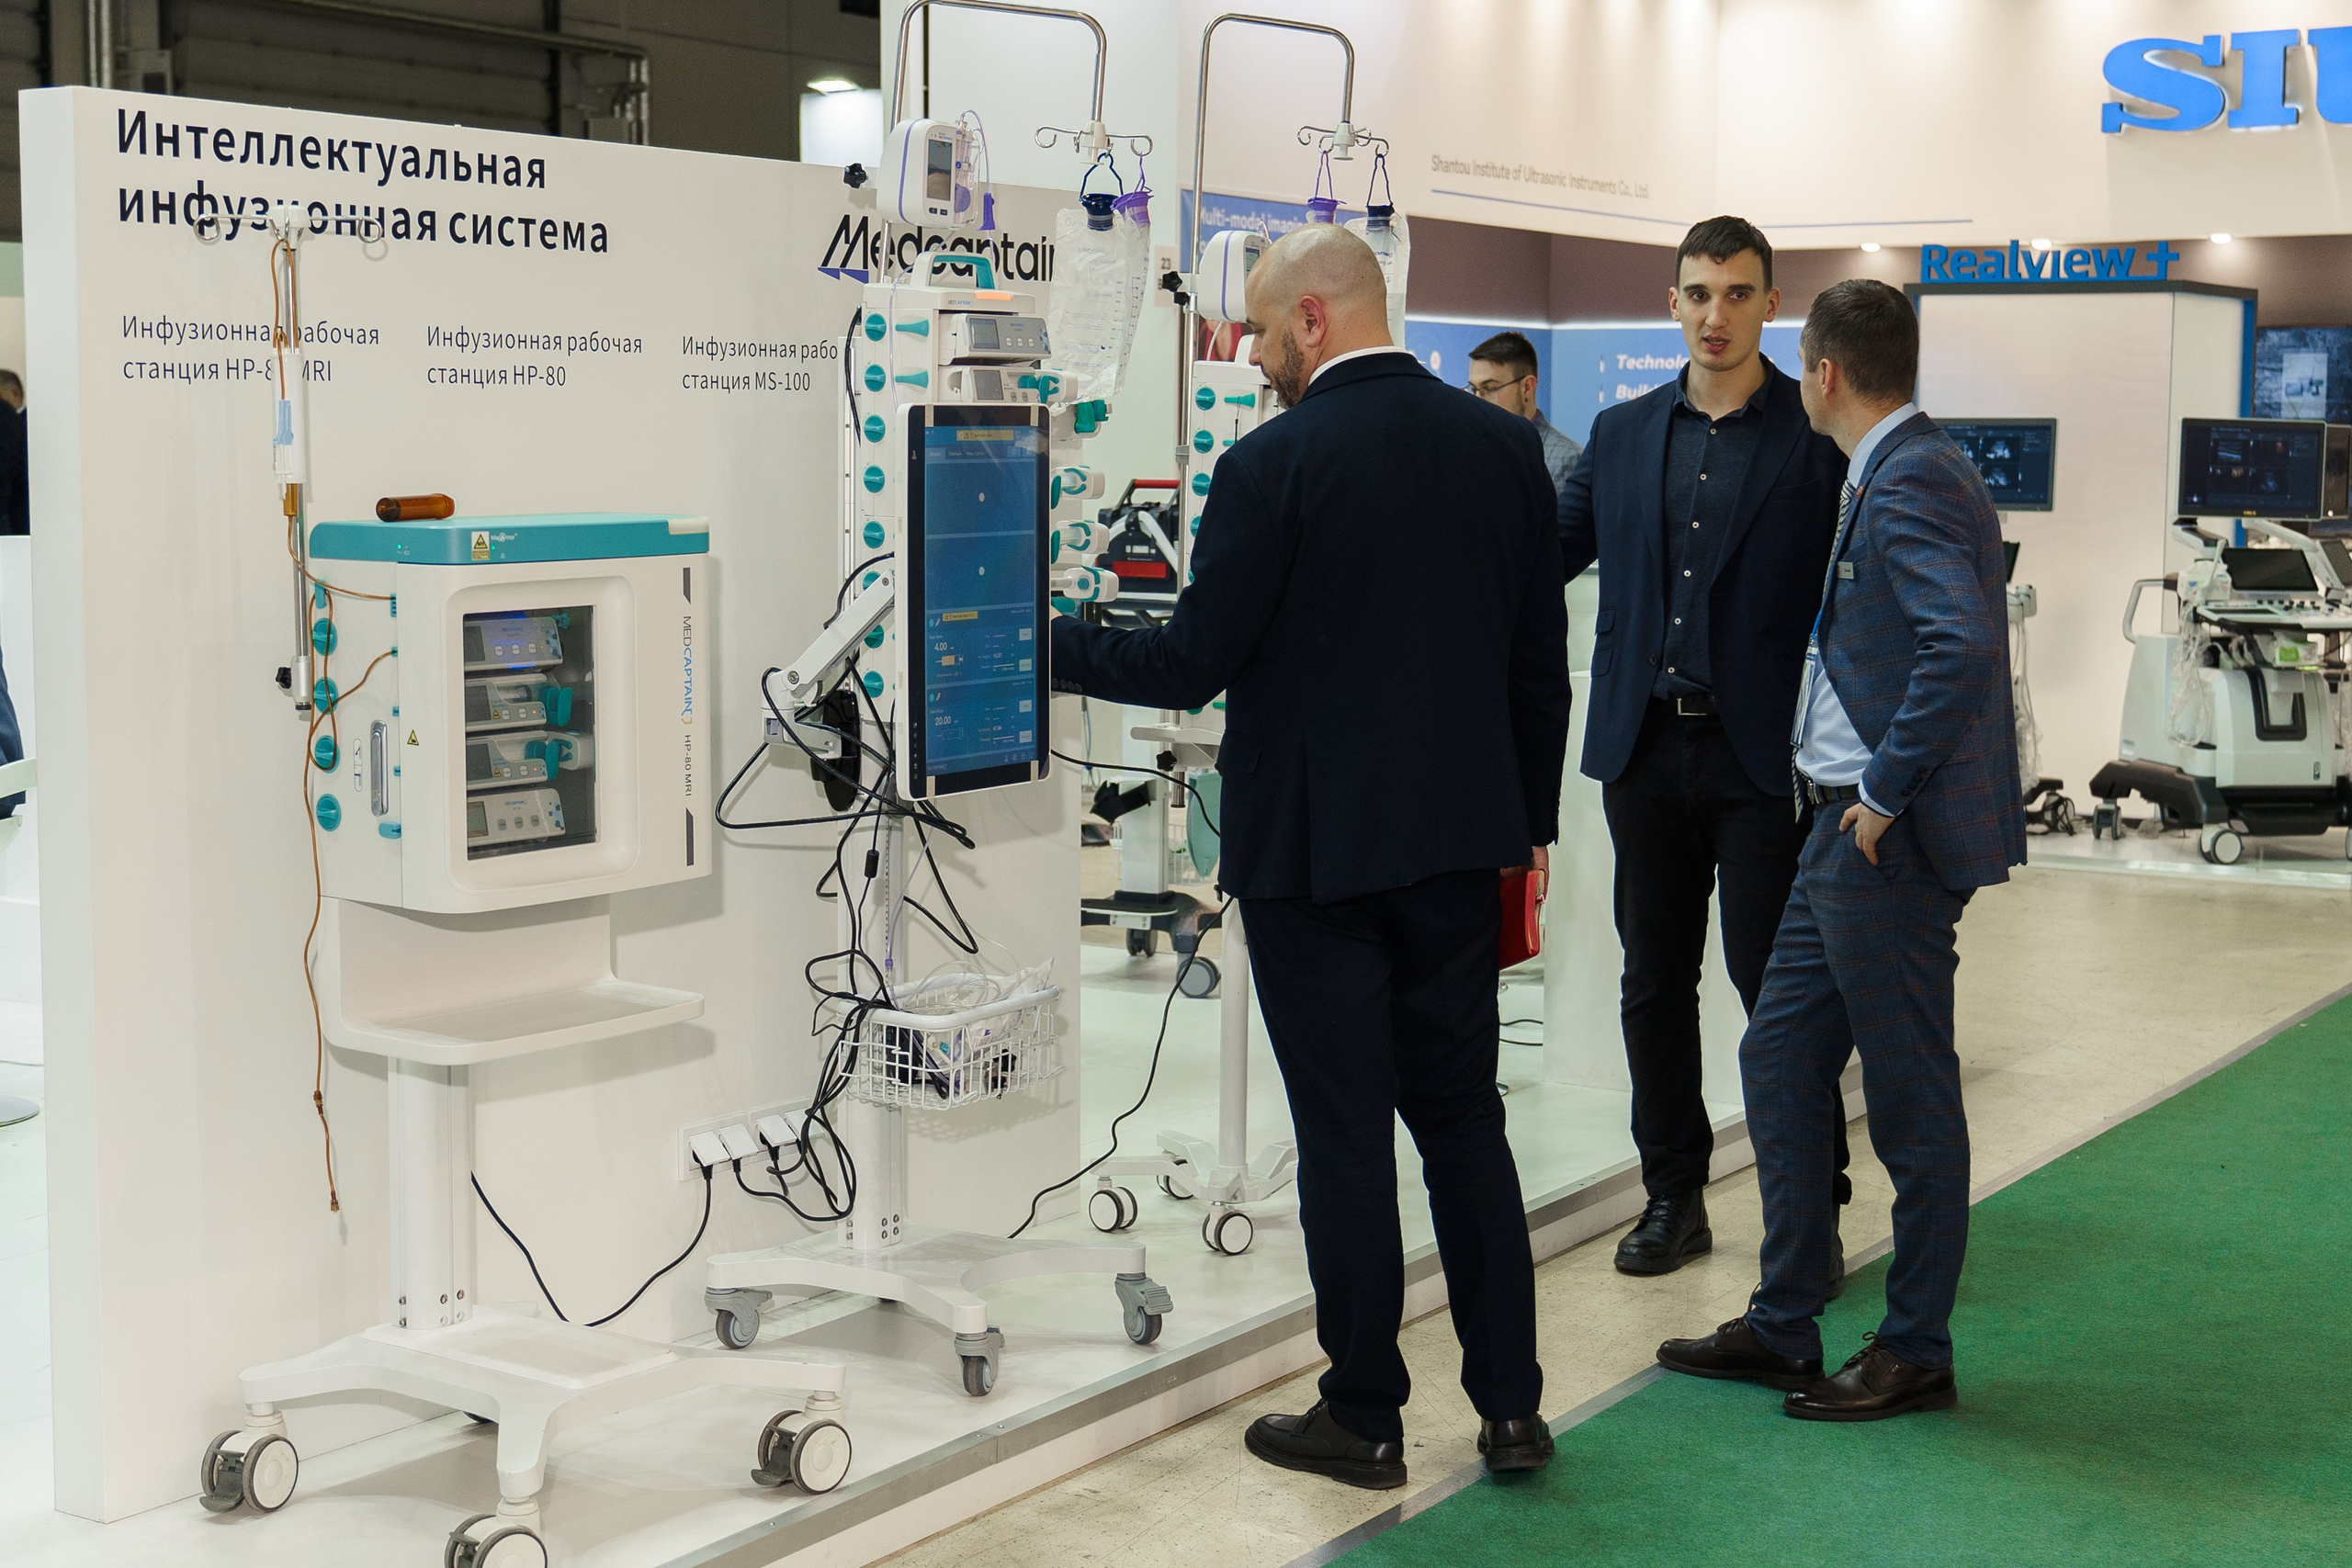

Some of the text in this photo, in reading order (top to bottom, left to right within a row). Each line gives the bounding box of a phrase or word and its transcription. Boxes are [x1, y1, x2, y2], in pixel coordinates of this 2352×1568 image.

[118, 108, 548, 189] Интеллектуальная
[1431, 154, 1470, 175] Shantou
[1472, 159, 1510, 180] Institute
[1512, 166, 1521, 181] of
[1522, 165, 1566, 187] Ultrasonic
[1569, 172, 1617, 195] Instruments
[1634, 184, 1650, 199] Ltd.
[448, 209, 609, 254] система
[1268, 213, 1306, 233] imagin
[1921, 239, 2135, 282] Realview
[427, 326, 642, 356] Инфузионная рабочая
[683, 335, 838, 363] Инфузионная рабо
[123, 360, 219, 385] станция
[226, 358, 272, 380] HP-8
[1616, 353, 1690, 370] Technolo
[427, 365, 566, 388] станция HP-80
[682, 371, 810, 393] станция MS-100
[682, 615, 693, 716] MEDCAPTAIN
